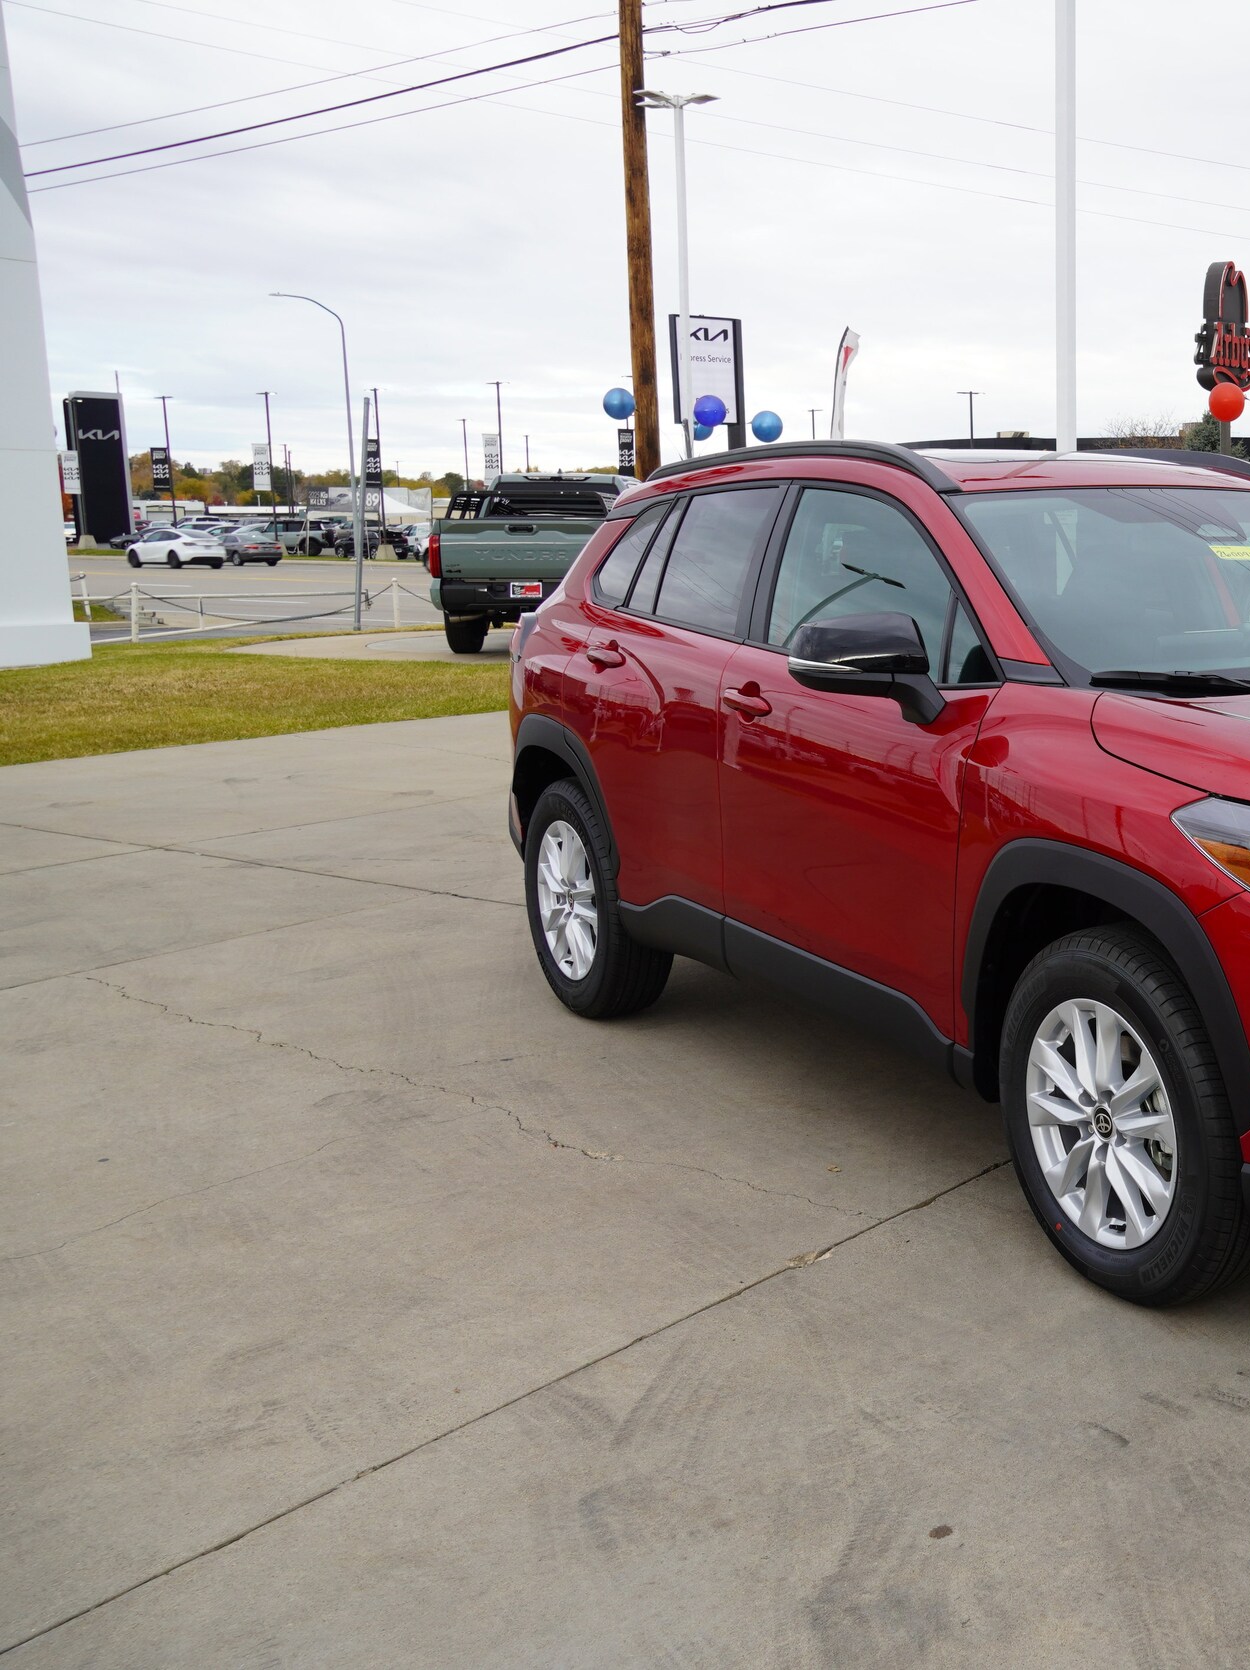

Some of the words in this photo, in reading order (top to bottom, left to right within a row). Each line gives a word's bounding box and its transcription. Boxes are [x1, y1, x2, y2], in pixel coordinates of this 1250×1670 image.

[707, 354, 732, 364] Service
[78, 429, 120, 440] KIA
[474, 549, 569, 561] TUNDRA
[1141, 1216, 1190, 1284] MICHELIN
